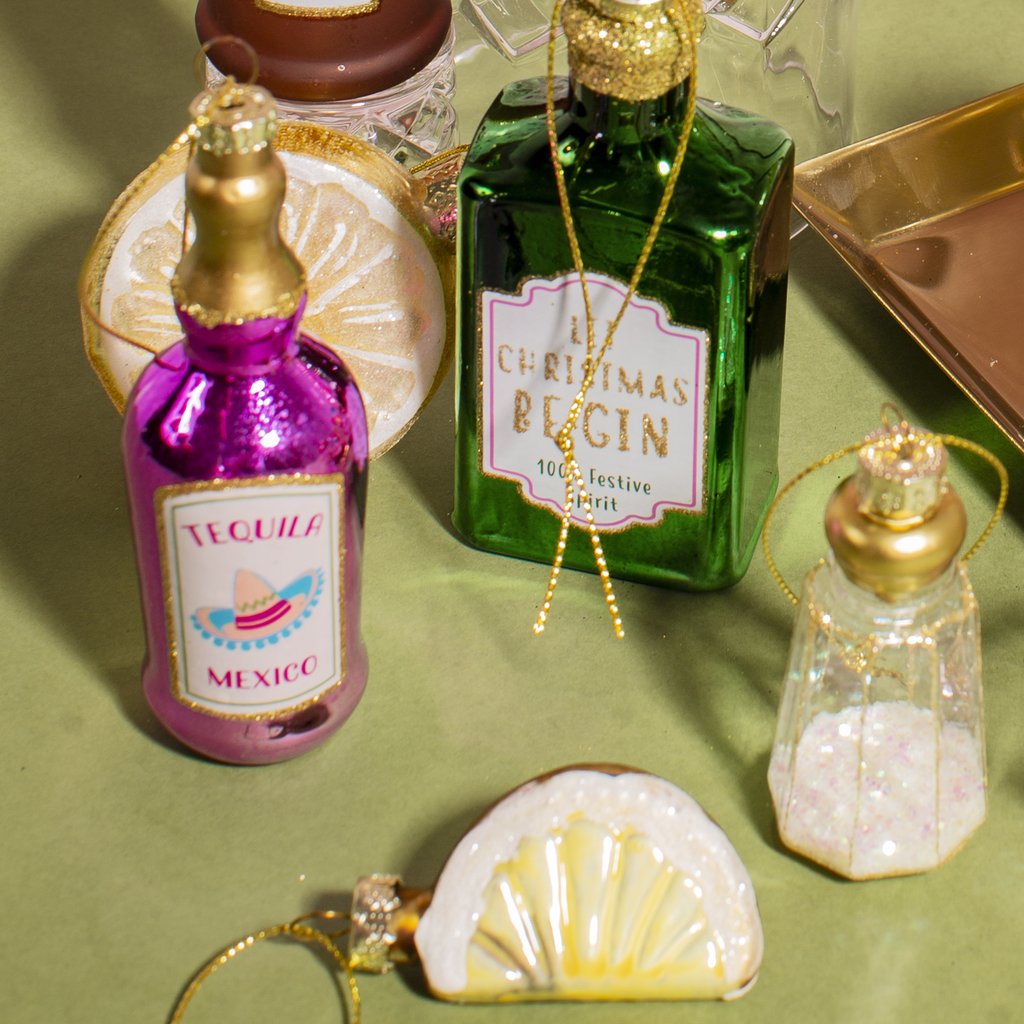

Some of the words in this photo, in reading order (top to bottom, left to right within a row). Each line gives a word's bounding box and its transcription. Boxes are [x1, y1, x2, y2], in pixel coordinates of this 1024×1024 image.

[498, 344, 690, 406] CHRITMAS
[590, 468, 651, 495] Festive
[181, 513, 324, 547] TEQUILA
[207, 655, 318, 690] MEXICO
